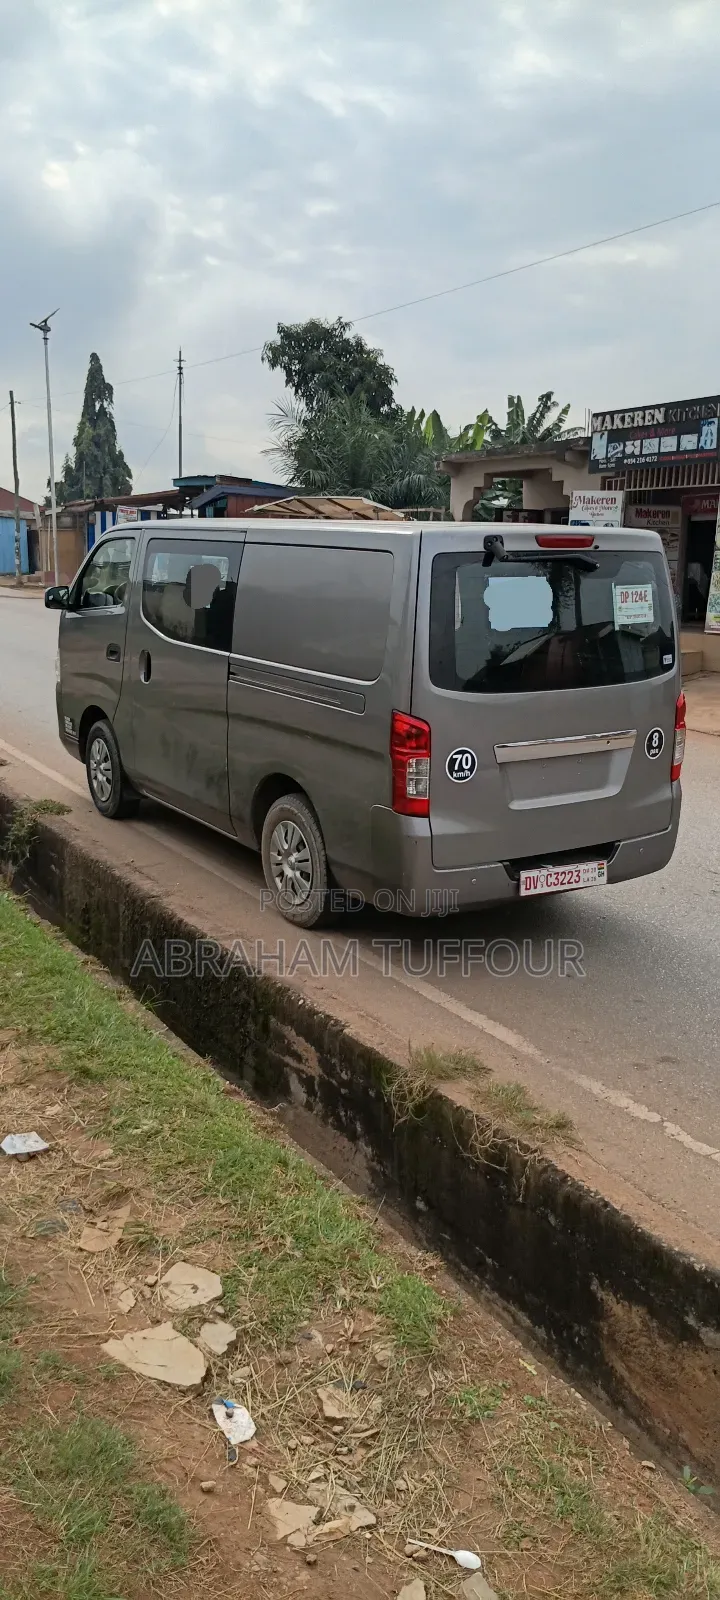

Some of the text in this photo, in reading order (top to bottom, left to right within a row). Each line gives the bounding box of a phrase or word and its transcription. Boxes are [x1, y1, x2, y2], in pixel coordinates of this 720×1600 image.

[591, 402, 720, 432] MAKEREN KITCHEN
[649, 427, 656, 438] &
[657, 427, 676, 437] More
[573, 495, 617, 508] Makeren
[635, 507, 670, 520] Makeren
[620, 590, 629, 604] DP
[652, 733, 659, 747] 8
[452, 753, 472, 771] 70
[453, 770, 471, 778] km/h
[525, 869, 581, 890] DV C3223
